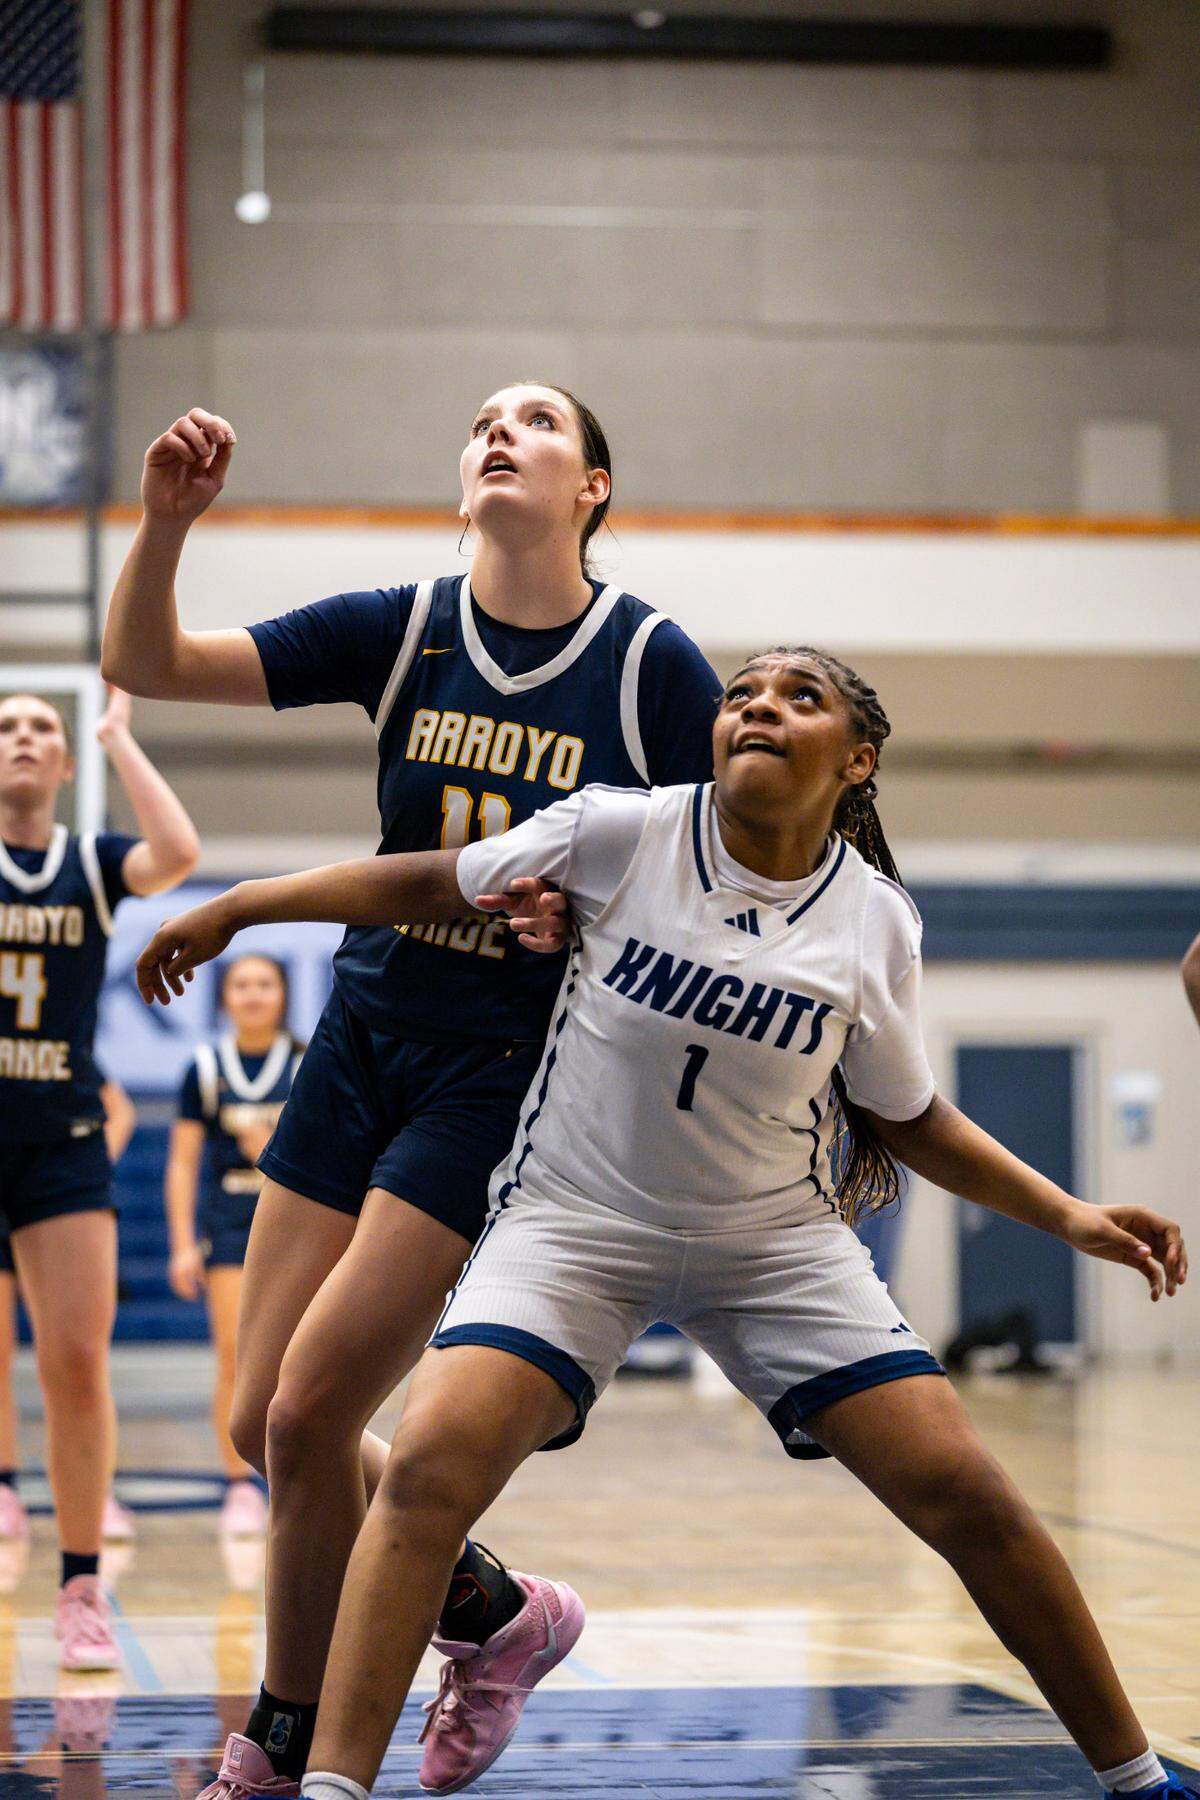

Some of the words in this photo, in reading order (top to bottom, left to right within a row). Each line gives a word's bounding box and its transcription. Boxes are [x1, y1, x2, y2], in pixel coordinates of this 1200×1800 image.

[405, 708, 585, 790] ARROYO
[0, 952, 46, 1030] 4
[602, 937, 835, 1055] KNIGHTS
[676, 1043, 709, 1112] 1
